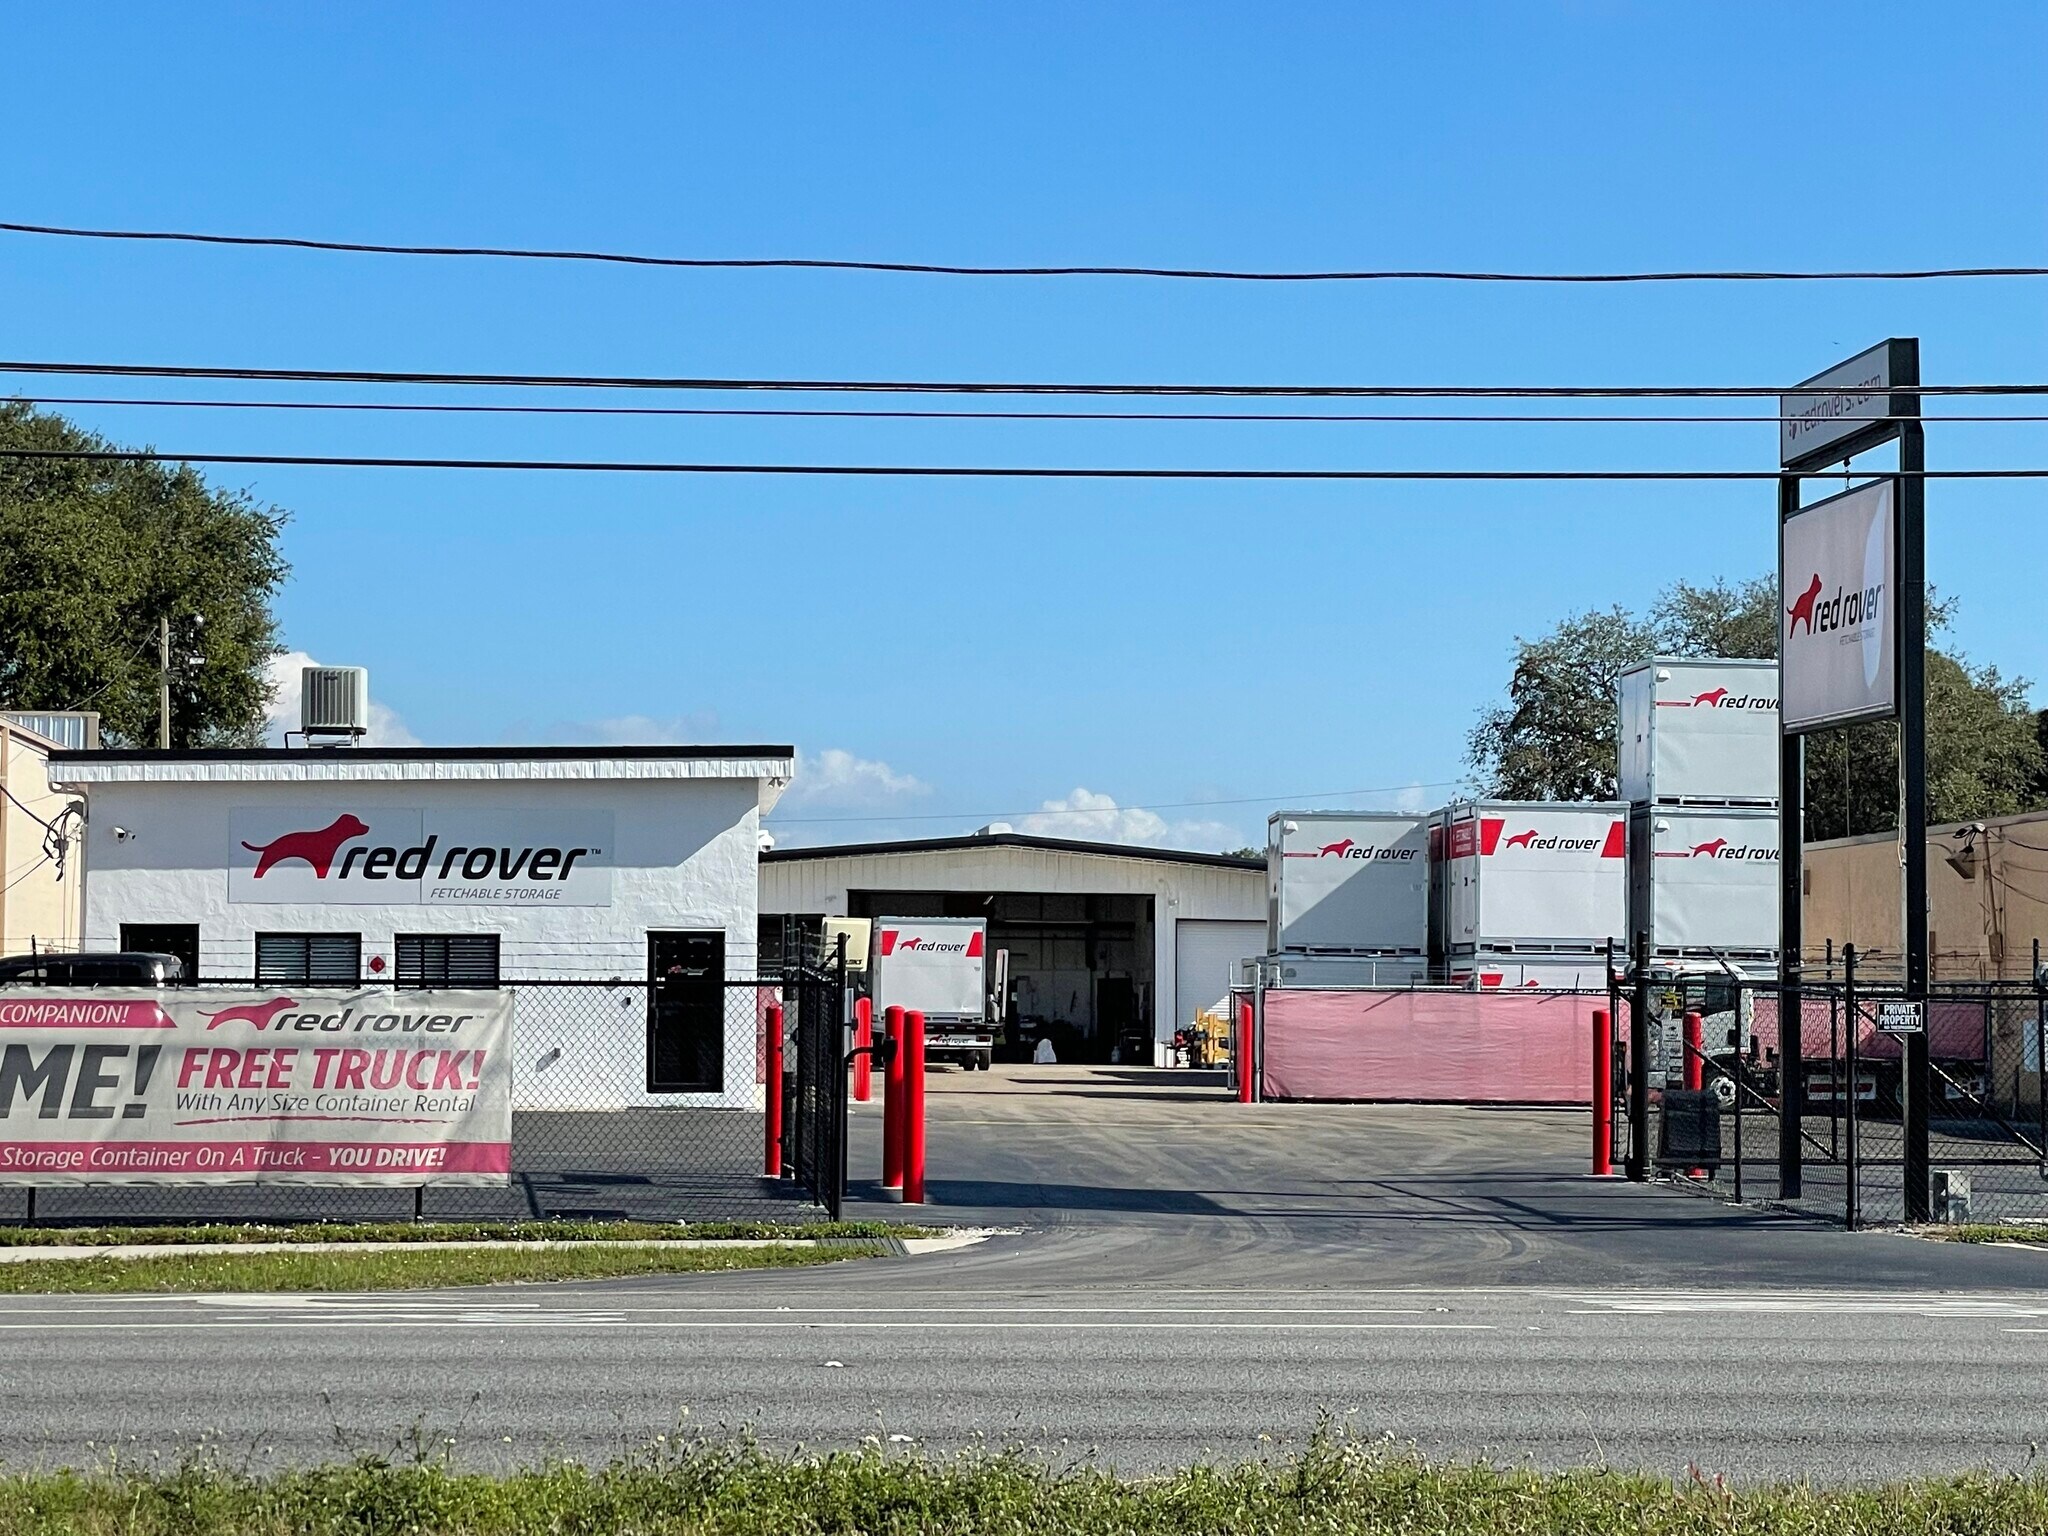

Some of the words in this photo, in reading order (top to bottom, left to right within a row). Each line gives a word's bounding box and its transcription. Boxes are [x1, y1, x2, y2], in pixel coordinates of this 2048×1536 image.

[1813, 586, 1842, 634] red
[1842, 584, 1882, 628] rover
[1718, 694, 1748, 708] red
[1748, 698, 1779, 709] rov
[1530, 835, 1558, 850] red
[1558, 838, 1601, 850] rover
[338, 834, 438, 880] red
[438, 846, 588, 881] rover
[1345, 845, 1374, 859] red
[1374, 848, 1418, 860] rover
[1717, 845, 1748, 859] red
[430, 887, 502, 899] FETCHABLE
[503, 888, 562, 900] STORAGE
[916, 941, 936, 952] red
[935, 942, 966, 952] rover
[0, 1004, 130, 1024] COMPANION!
[1883, 1004, 1916, 1015] PRIVATE
[274, 1007, 354, 1032] red
[353, 1012, 474, 1033] rover
[1879, 1014, 1920, 1025] PROPERTY
[177, 1047, 297, 1089] FREE
[312, 1049, 487, 1090] TRUCK!
[0, 1043, 162, 1120] ME!
[176, 1092, 222, 1111] With
[227, 1093, 264, 1114] Any
[270, 1092, 308, 1112] Size
[315, 1093, 409, 1112] Container
[414, 1094, 476, 1112] Rental
[1, 1147, 84, 1169] Storage
[90, 1147, 190, 1167] Container
[196, 1147, 224, 1167] On
[230, 1147, 245, 1166] A
[252, 1146, 306, 1167] Truck
[328, 1147, 372, 1166] YOU
[375, 1147, 447, 1167] DRIVE!
